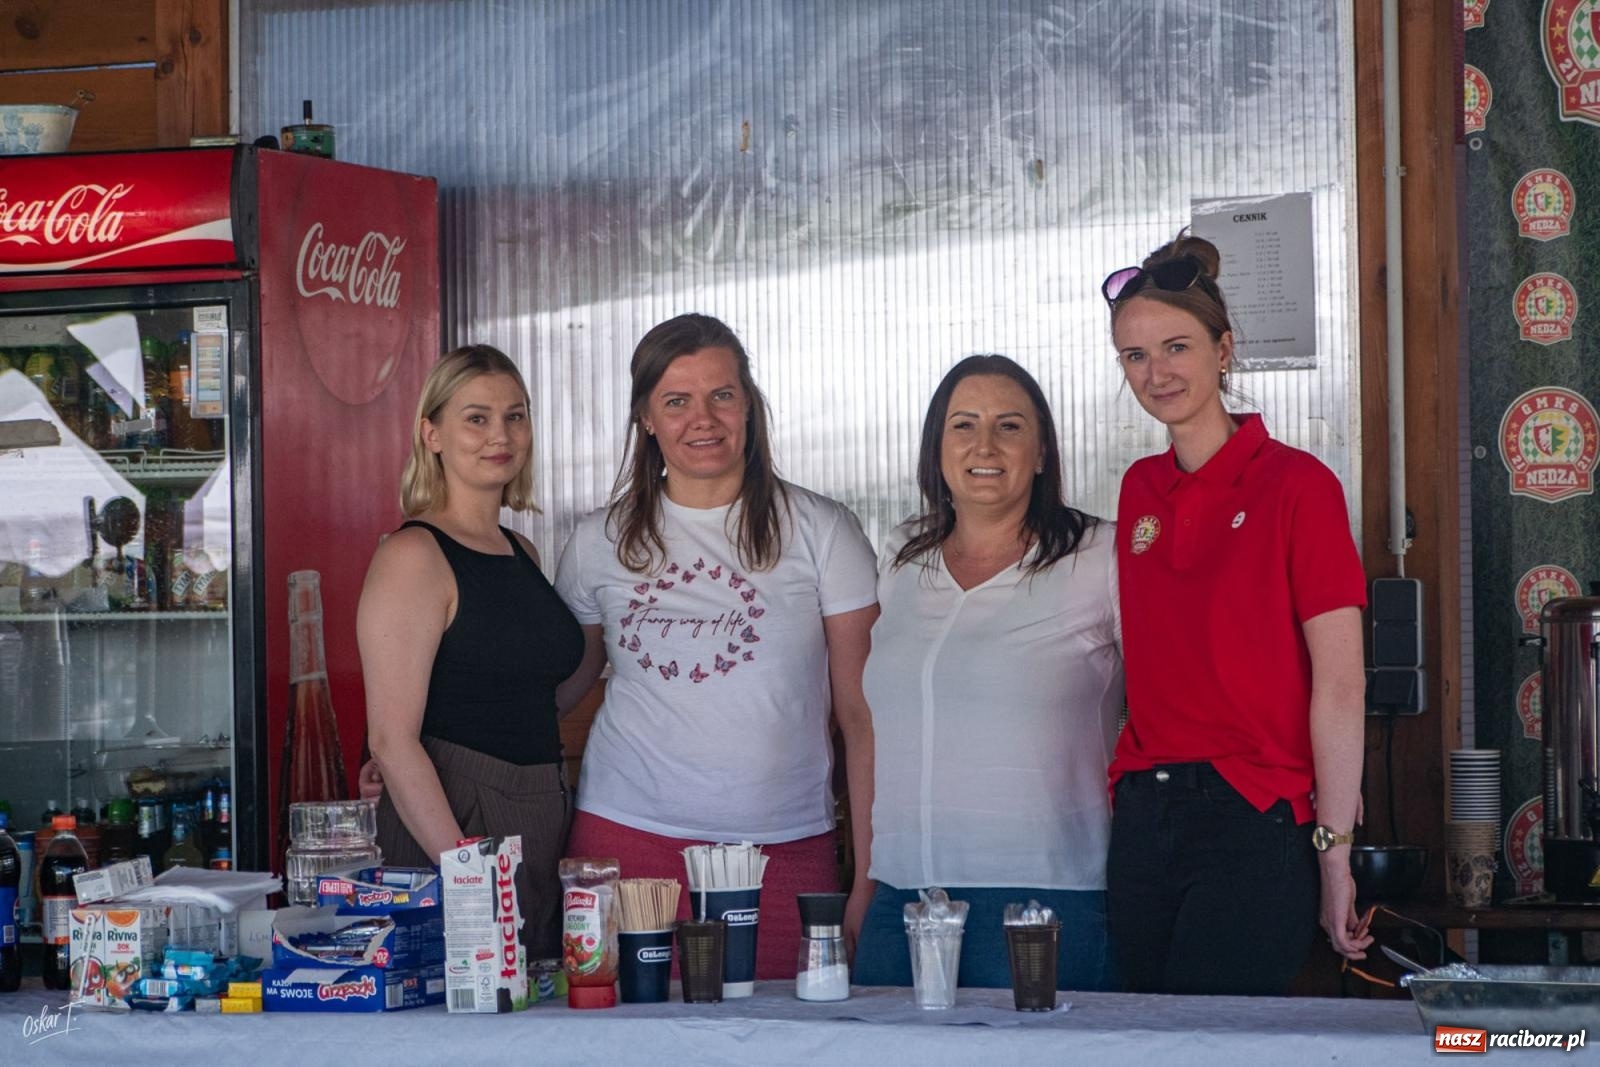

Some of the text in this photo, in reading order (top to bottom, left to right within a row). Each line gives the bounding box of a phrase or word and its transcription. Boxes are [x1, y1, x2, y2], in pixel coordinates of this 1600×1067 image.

[1559, 57, 1579, 82] 21
[0, 183, 135, 246] oca-Cola
[1233, 212, 1267, 223] CENNIK
[296, 222, 407, 308] Coca-Cola
[1521, 396, 1579, 416] GMKS
[1511, 455, 1526, 471] 21
[1577, 455, 1592, 470] 21
[679, 617, 708, 639] way
[711, 613, 725, 636] of
[724, 609, 747, 637] life
[280, 988, 314, 998] SWOJE
